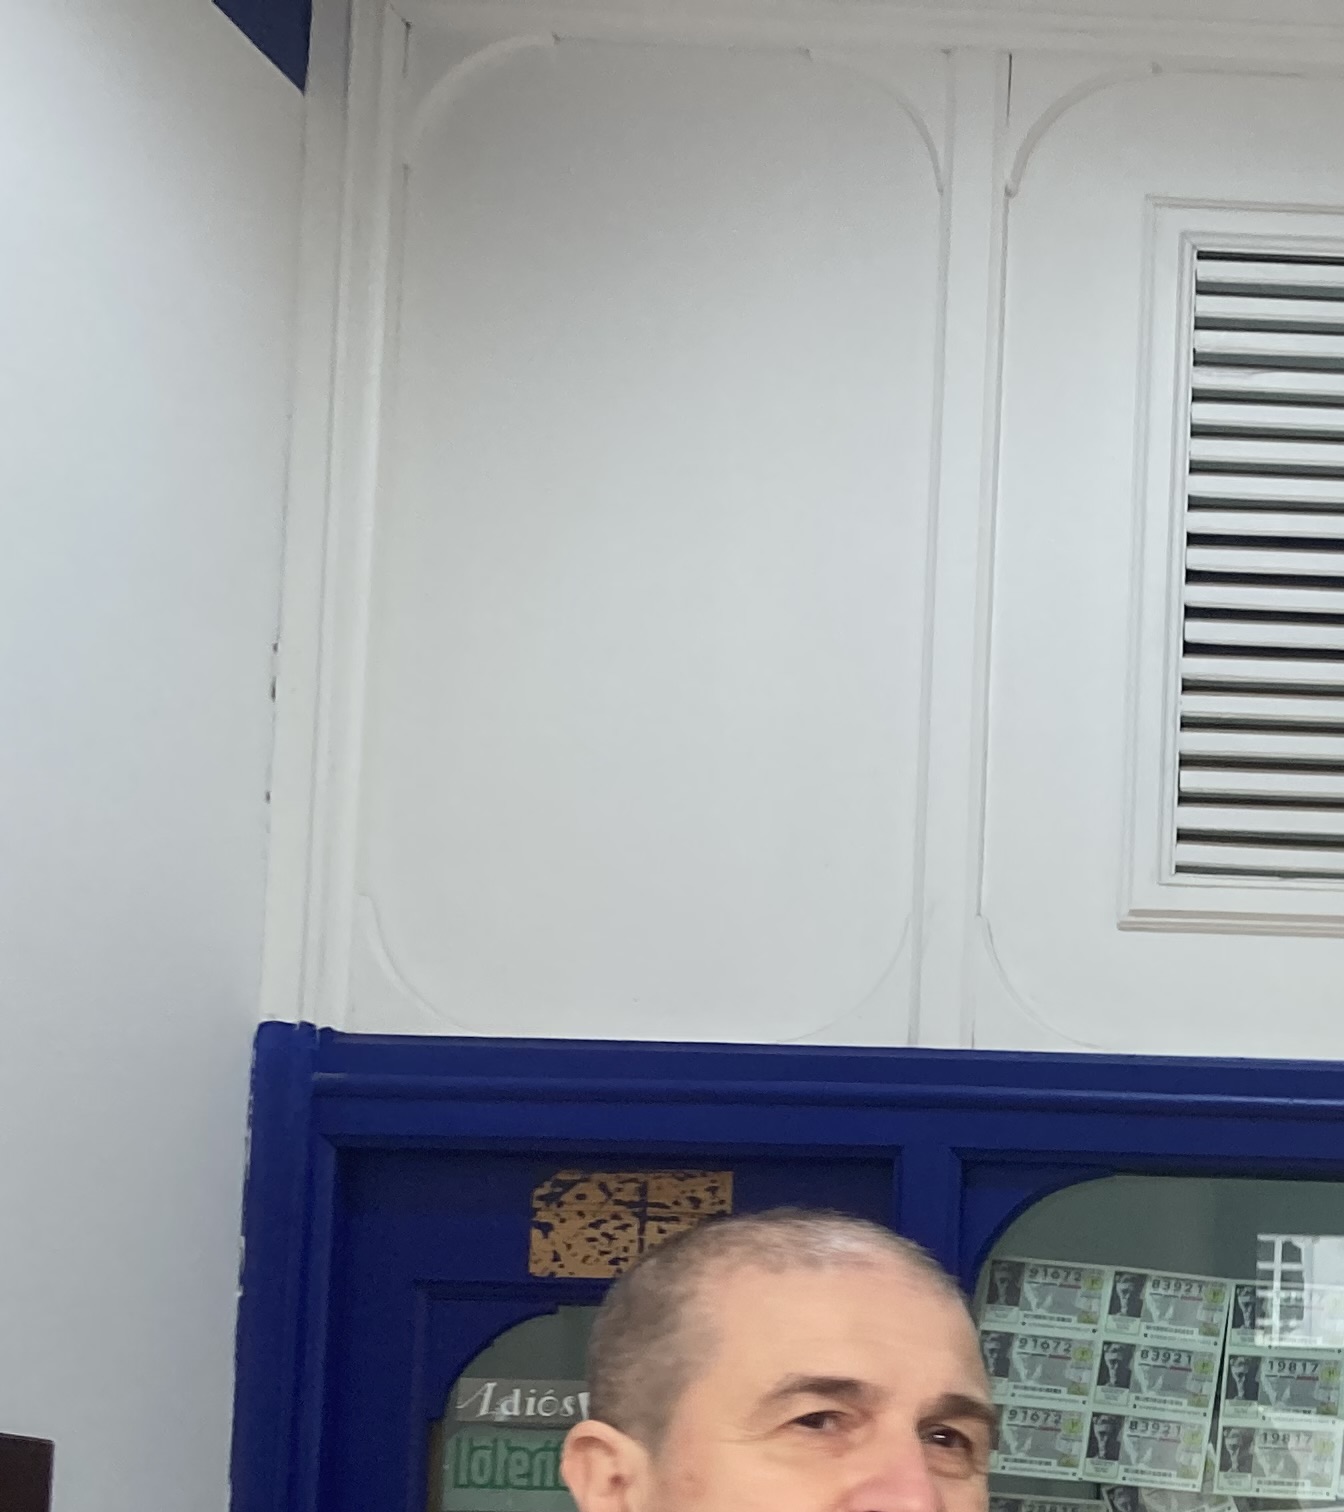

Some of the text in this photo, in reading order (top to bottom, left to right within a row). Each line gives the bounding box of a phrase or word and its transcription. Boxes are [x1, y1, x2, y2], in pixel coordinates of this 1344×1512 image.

[1027, 1267, 1082, 1282] 91672
[1018, 1338, 1073, 1352] 91672
[1140, 1349, 1193, 1364] 83921
[1267, 1361, 1320, 1374] 19817
[1007, 1409, 1062, 1423] 91672
